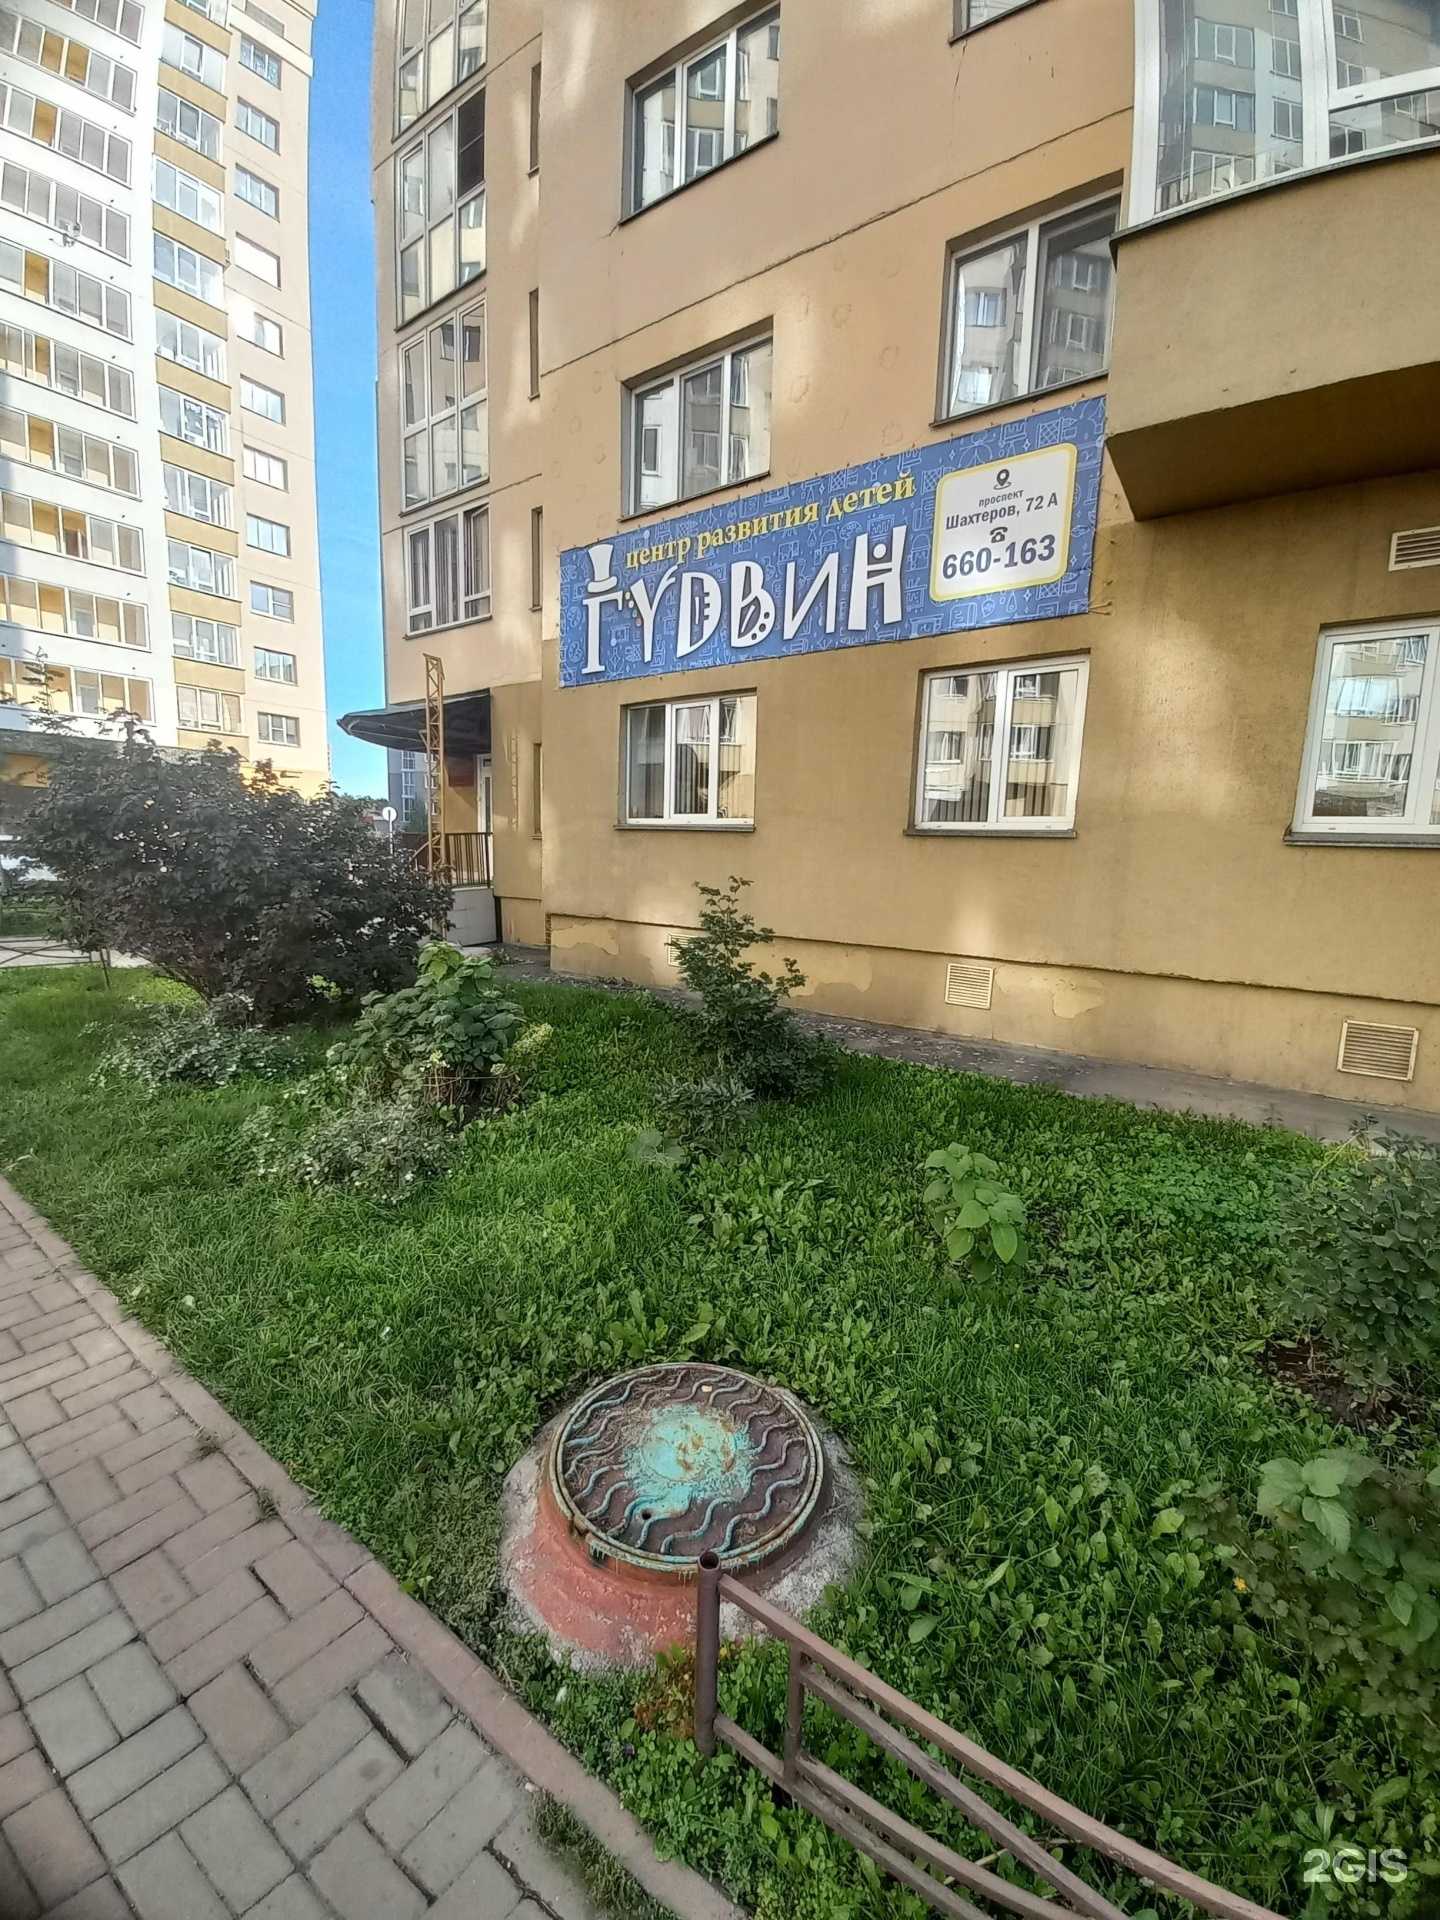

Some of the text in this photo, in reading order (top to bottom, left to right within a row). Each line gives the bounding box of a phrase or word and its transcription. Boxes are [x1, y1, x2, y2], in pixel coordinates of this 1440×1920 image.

[945, 503, 1020, 530] Шахтеров,
[1025, 495, 1043, 512] 72
[978, 489, 1024, 507] проспект
[626, 475, 915, 569] центр развития детей
[942, 534, 1056, 579] 660-163
[580, 525, 907, 675] ГУДВИН
